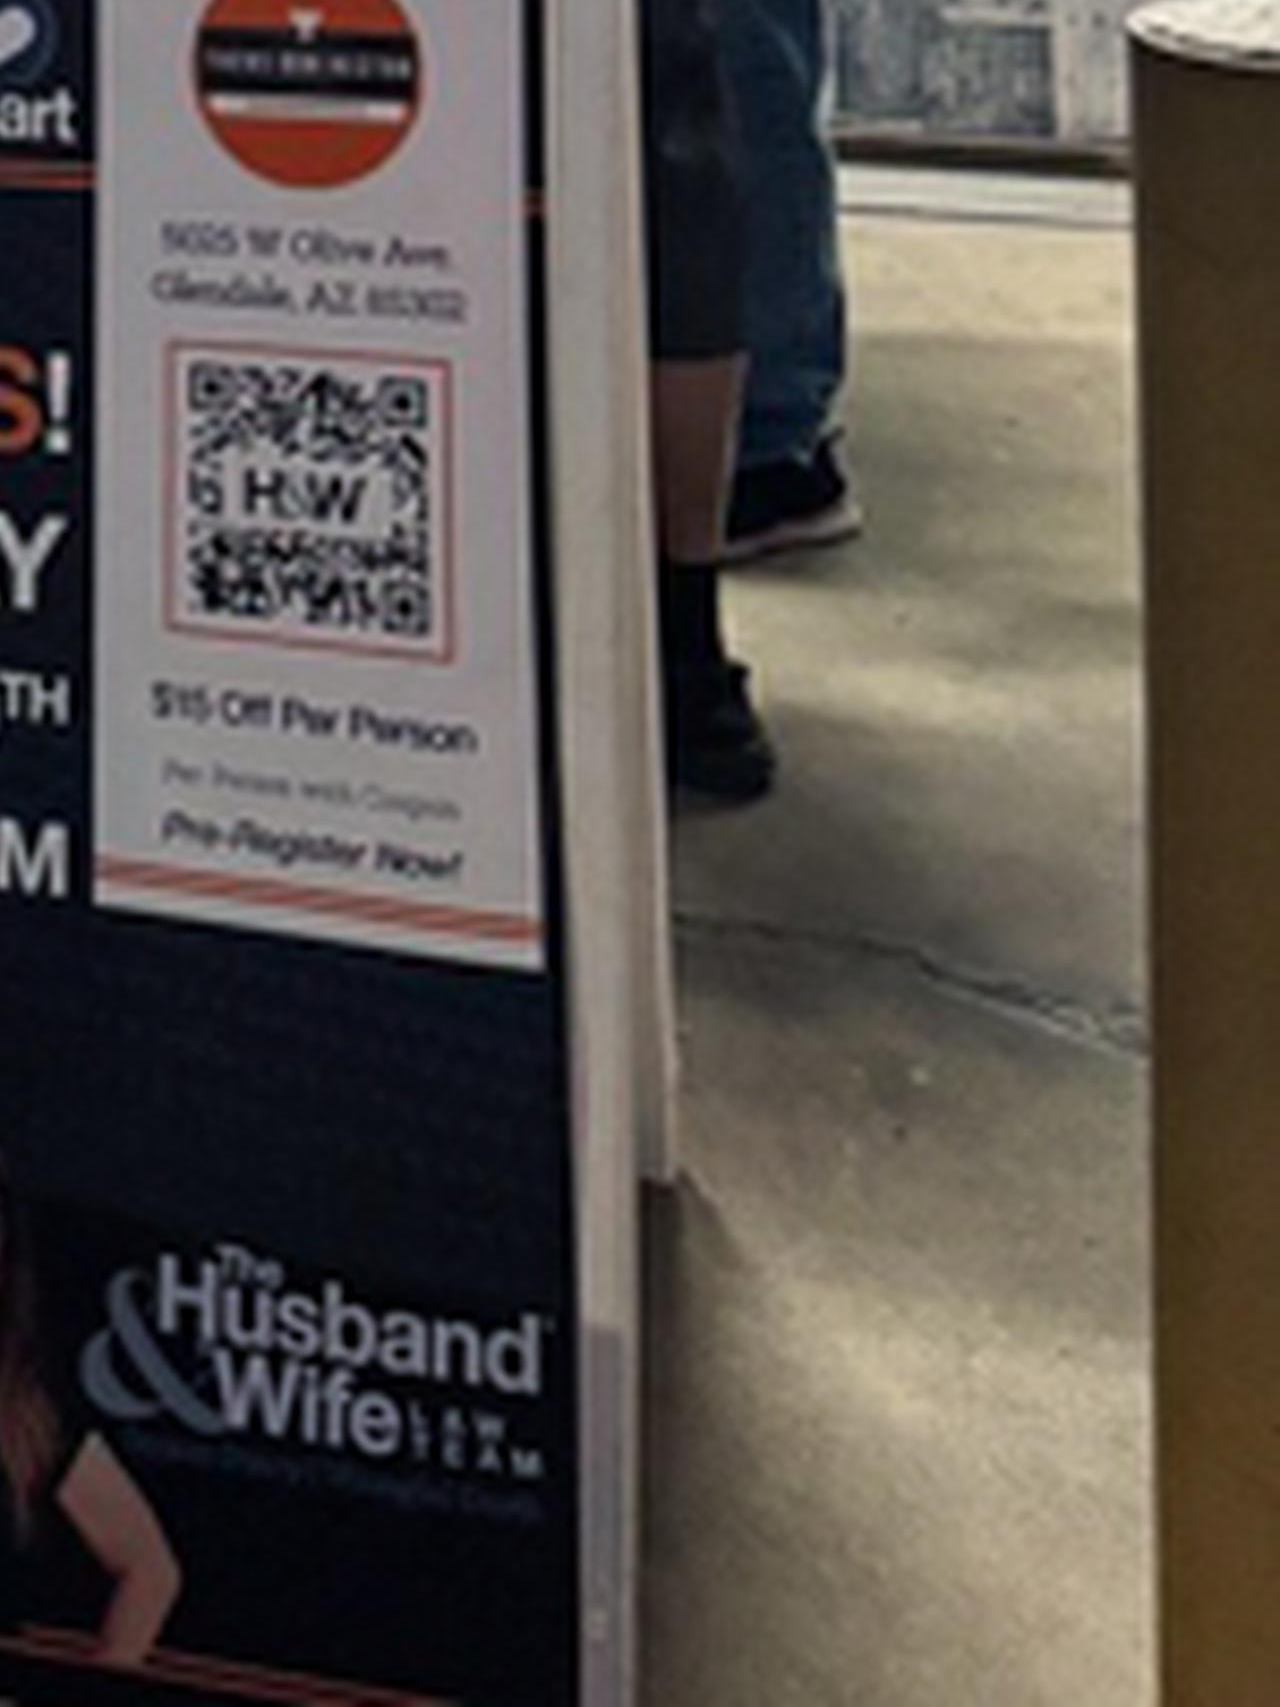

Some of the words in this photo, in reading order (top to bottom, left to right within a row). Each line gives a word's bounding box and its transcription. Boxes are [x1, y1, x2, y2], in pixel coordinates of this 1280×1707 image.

[306, 281, 359, 318] AZ
[219, 689, 275, 728] Off
[281, 696, 341, 737] Per
[348, 704, 480, 755] Person
[215, 1241, 288, 1289] The
[157, 1251, 543, 1397] Husband
[211, 1347, 402, 1459] Wife
